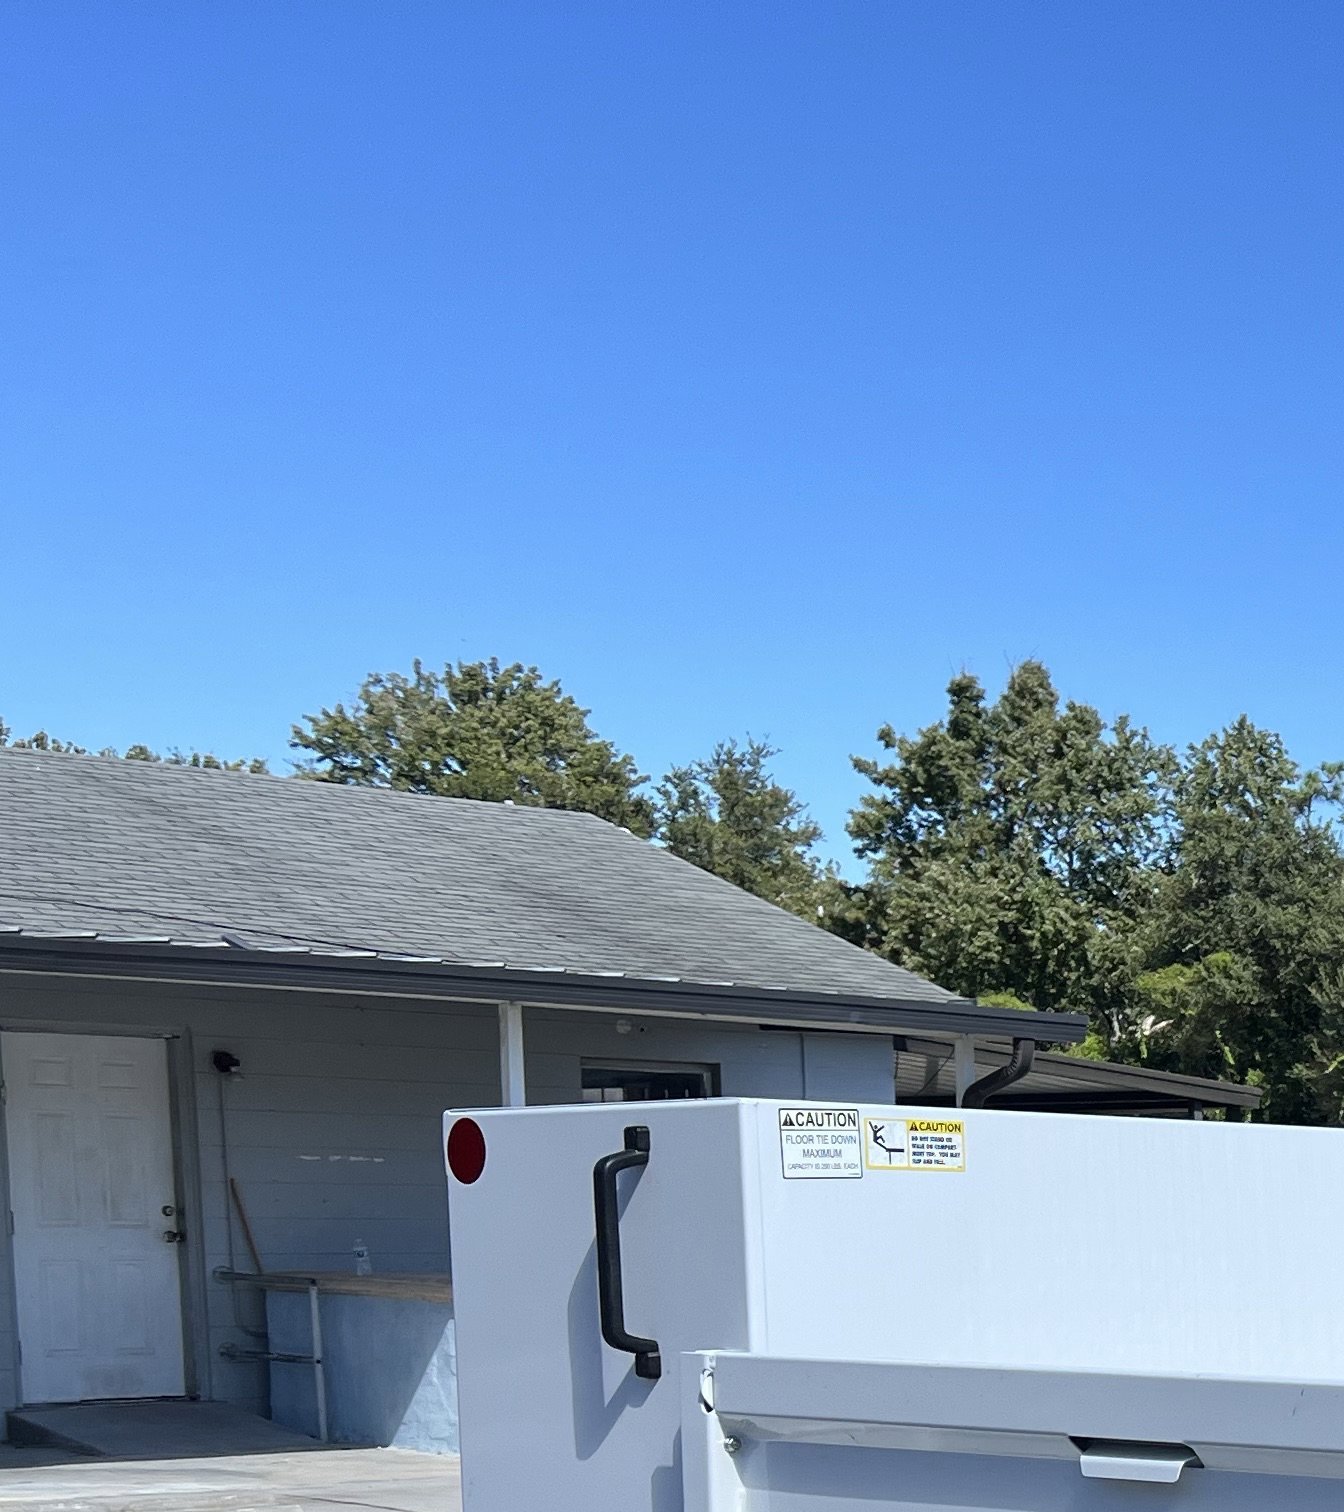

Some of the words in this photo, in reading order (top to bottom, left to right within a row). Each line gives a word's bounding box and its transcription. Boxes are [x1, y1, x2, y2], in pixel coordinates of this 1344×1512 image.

[795, 1111, 857, 1127] CAUTION
[919, 1121, 961, 1133] CAUTION
[785, 1134, 814, 1145] FLOOR
[816, 1134, 829, 1145] TIE
[831, 1134, 857, 1145] DOWN
[802, 1148, 843, 1158] MAXIMUM
